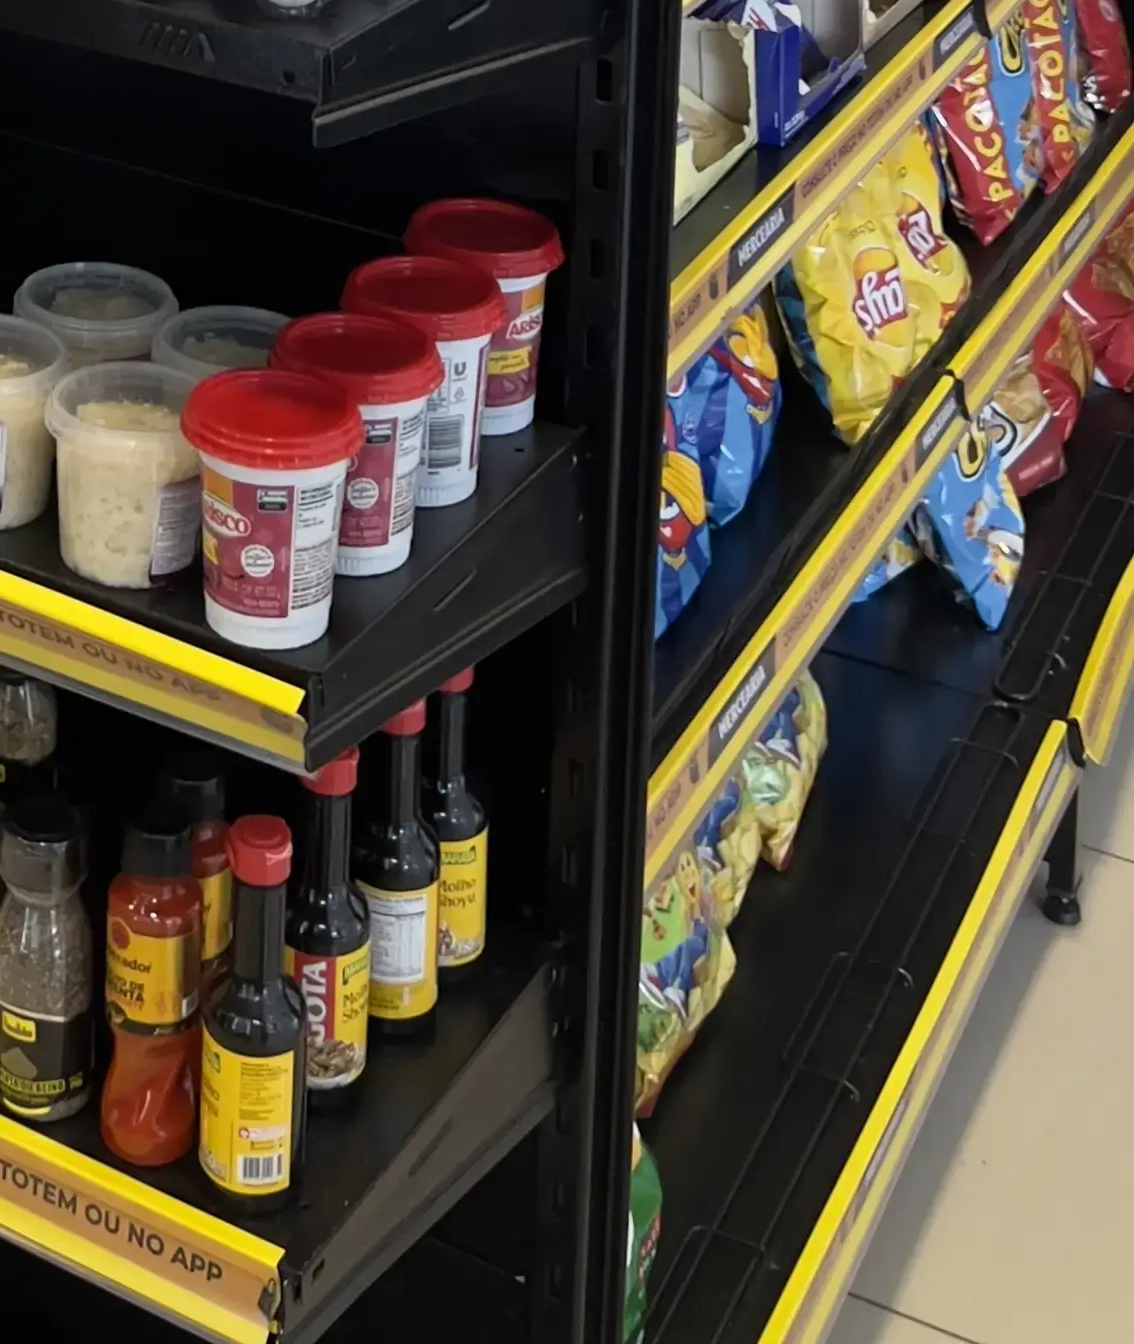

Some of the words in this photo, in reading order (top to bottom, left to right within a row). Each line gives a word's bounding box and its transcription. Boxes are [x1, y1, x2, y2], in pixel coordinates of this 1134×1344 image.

[737, 206, 786, 268] MERCEARIA
[82, 640, 117, 664] OU
[125, 656, 164, 681] NO
[83, 1203, 121, 1235] OU
[128, 1222, 165, 1257] NO
[169, 1245, 224, 1283] APP
